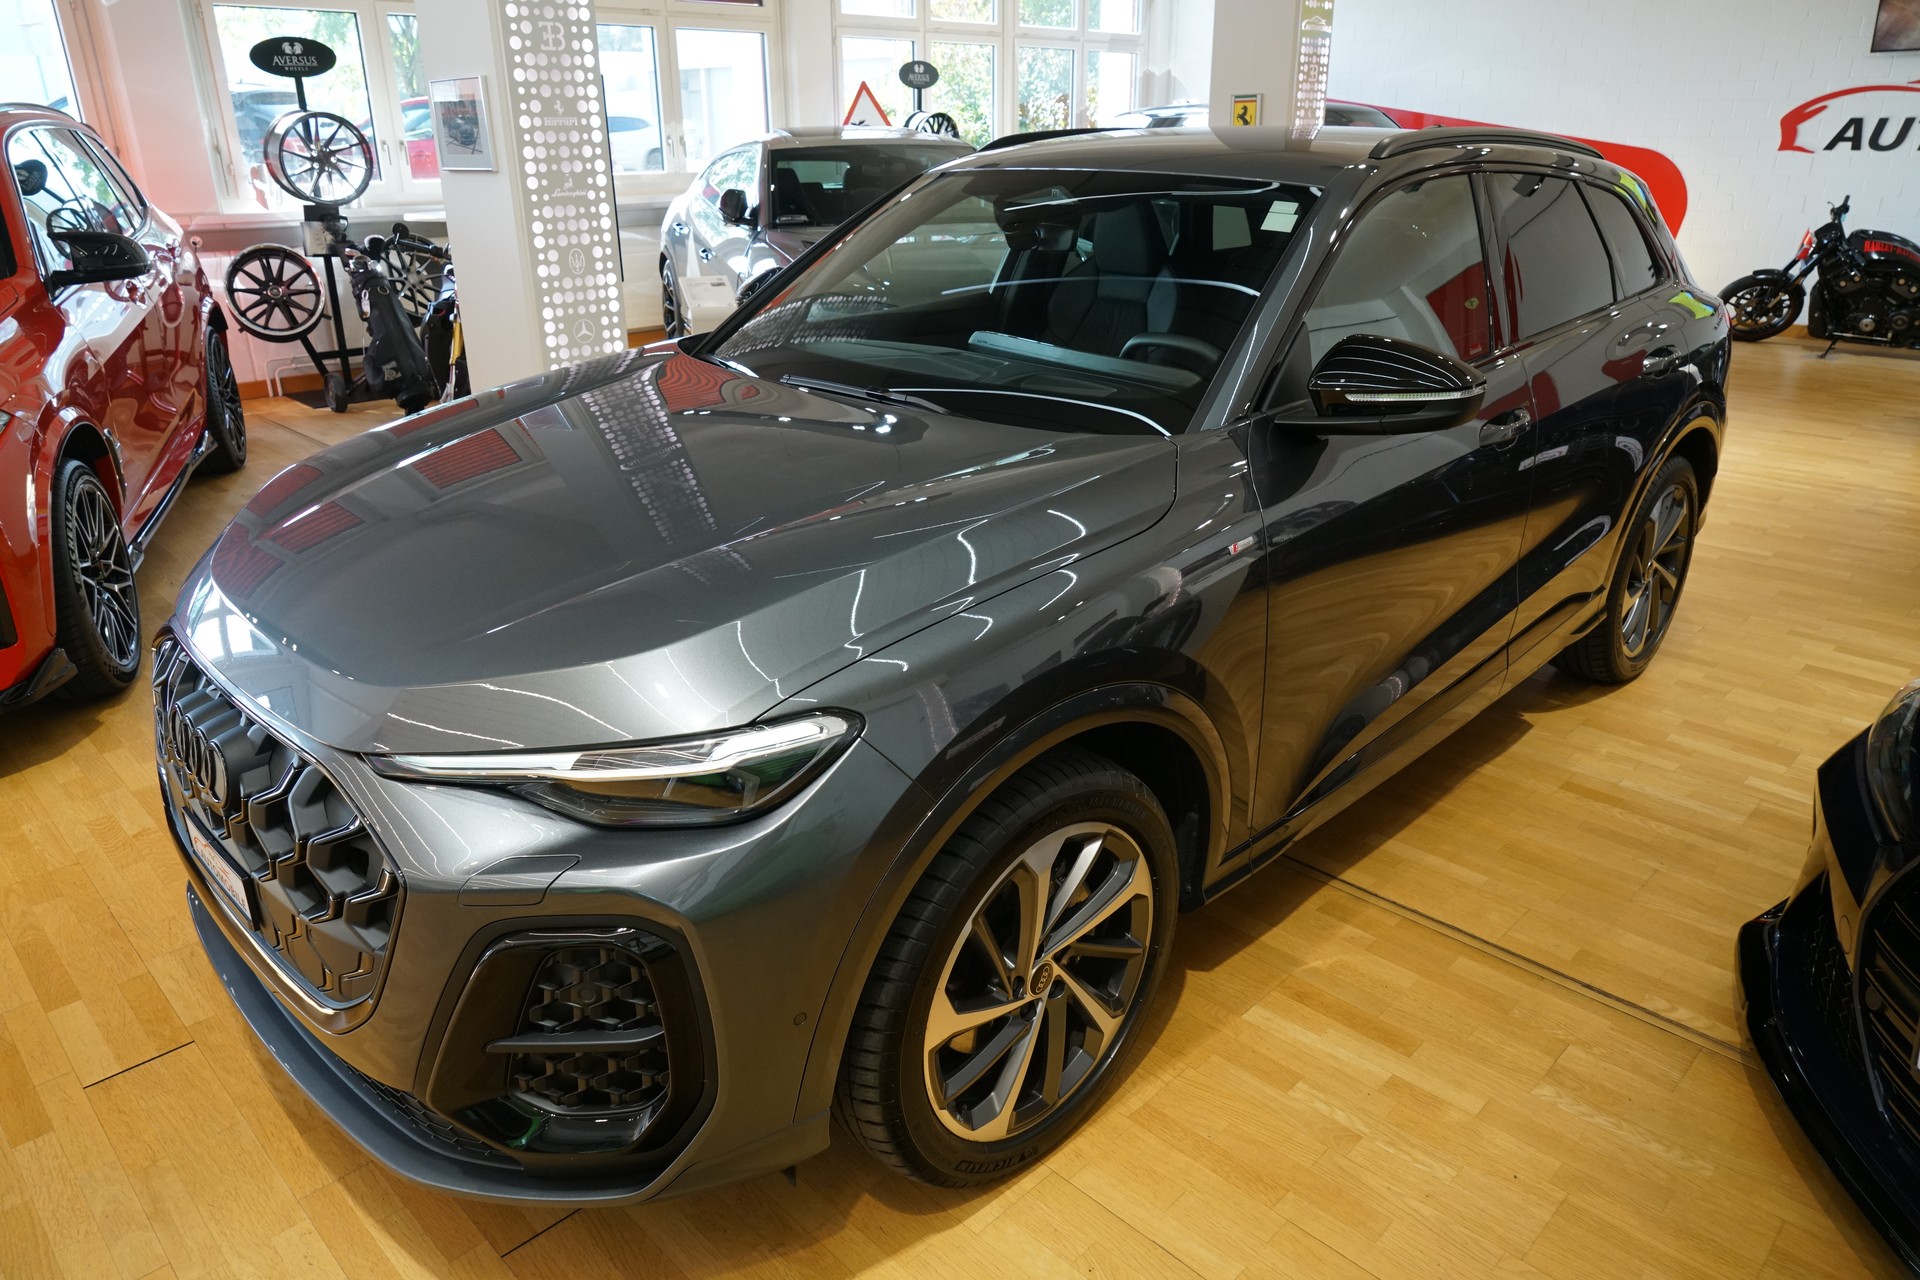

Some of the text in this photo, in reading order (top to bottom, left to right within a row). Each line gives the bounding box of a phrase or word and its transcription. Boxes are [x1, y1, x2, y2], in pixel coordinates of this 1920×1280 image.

[272, 55, 318, 66] AVERSUS
[1822, 117, 1920, 151] AU
[64, 500, 81, 585] MICHELIN
